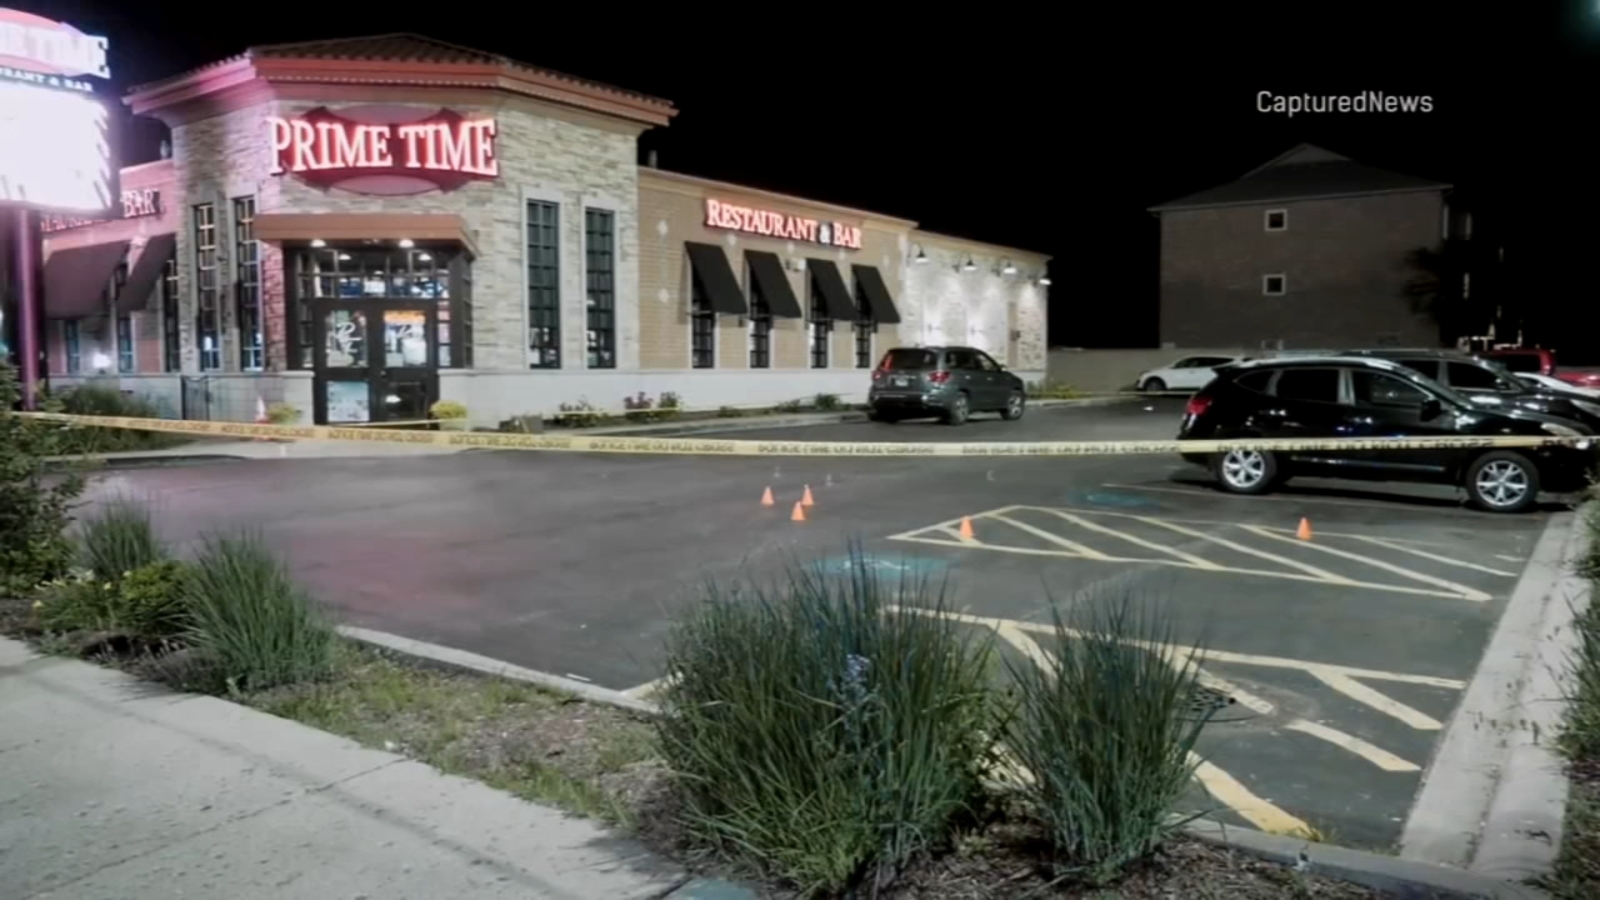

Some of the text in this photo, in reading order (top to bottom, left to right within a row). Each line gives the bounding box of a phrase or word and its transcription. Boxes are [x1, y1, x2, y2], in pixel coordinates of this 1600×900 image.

[0, 67, 44, 84] RANT
[64, 79, 93, 92] BAR
[266, 116, 498, 176] PRIME TIME
[706, 198, 862, 249] RESTAURANT & BAR
